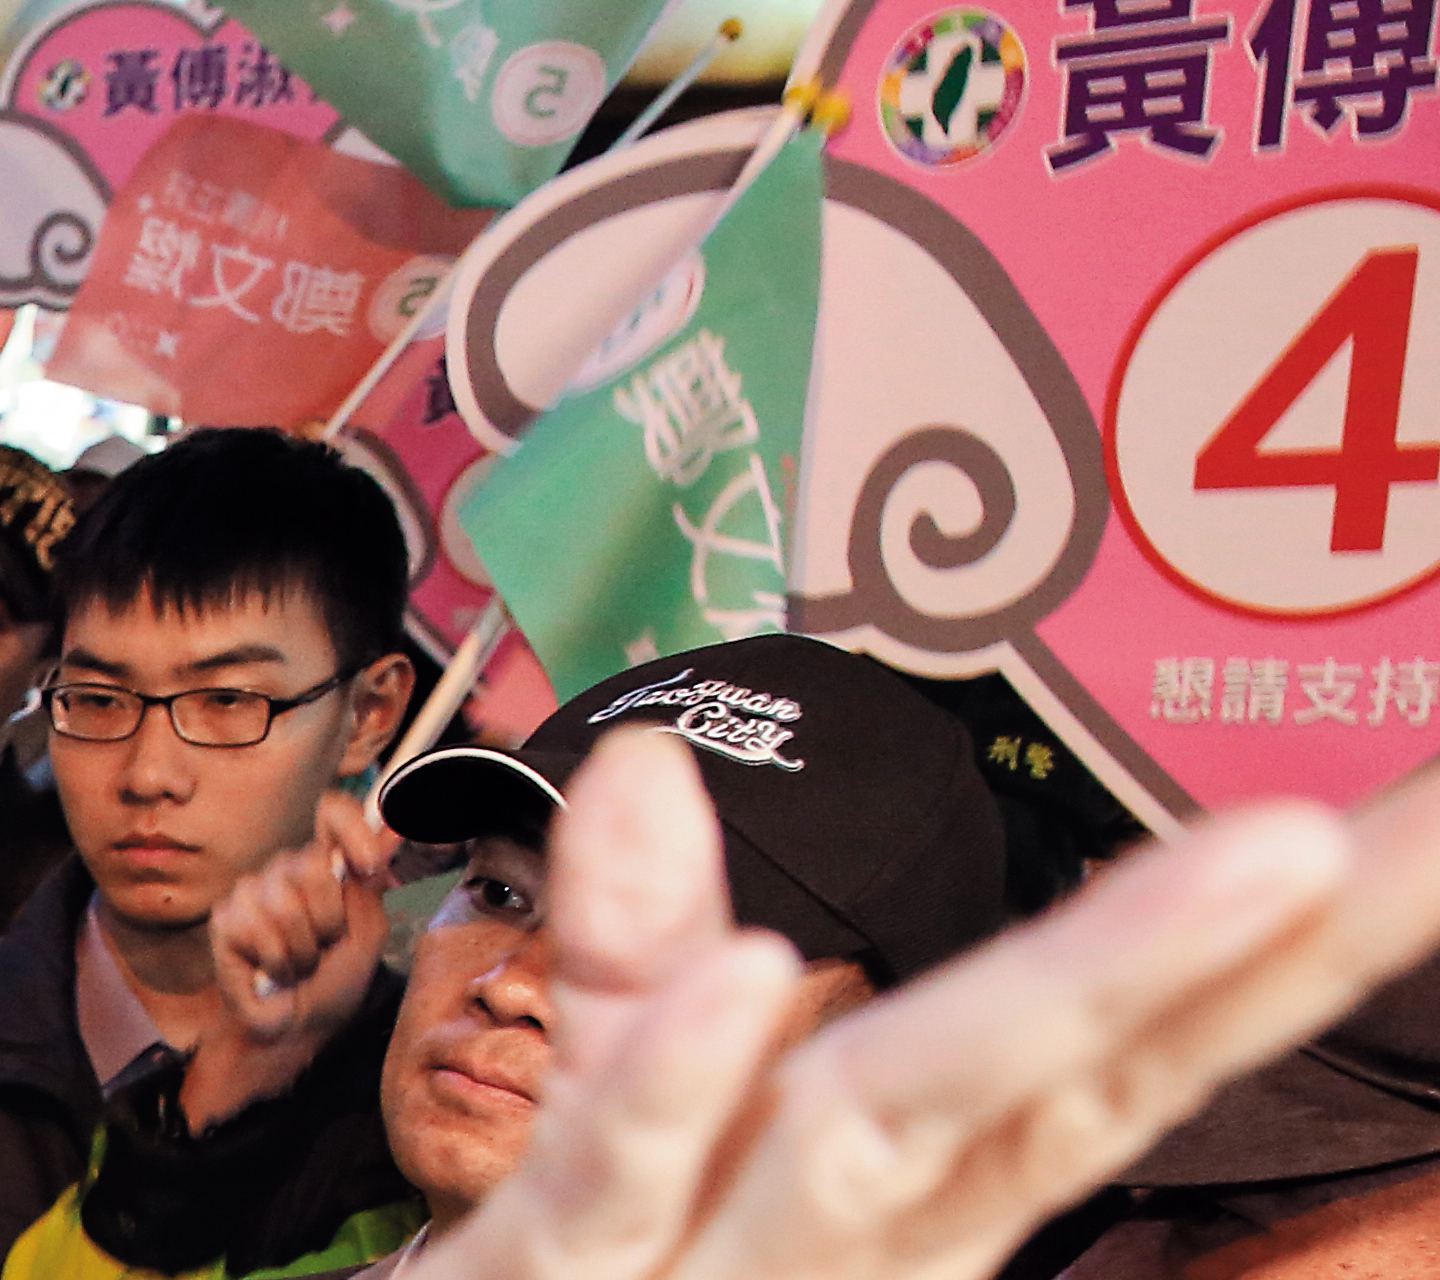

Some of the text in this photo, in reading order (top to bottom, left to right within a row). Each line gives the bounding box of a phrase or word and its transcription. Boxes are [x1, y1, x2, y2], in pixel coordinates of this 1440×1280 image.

[1193, 244, 1440, 553] 4
[587, 667, 803, 723] Taoyuan
[1149, 655, 1440, 728] 懇請支持
[673, 701, 806, 773] City
